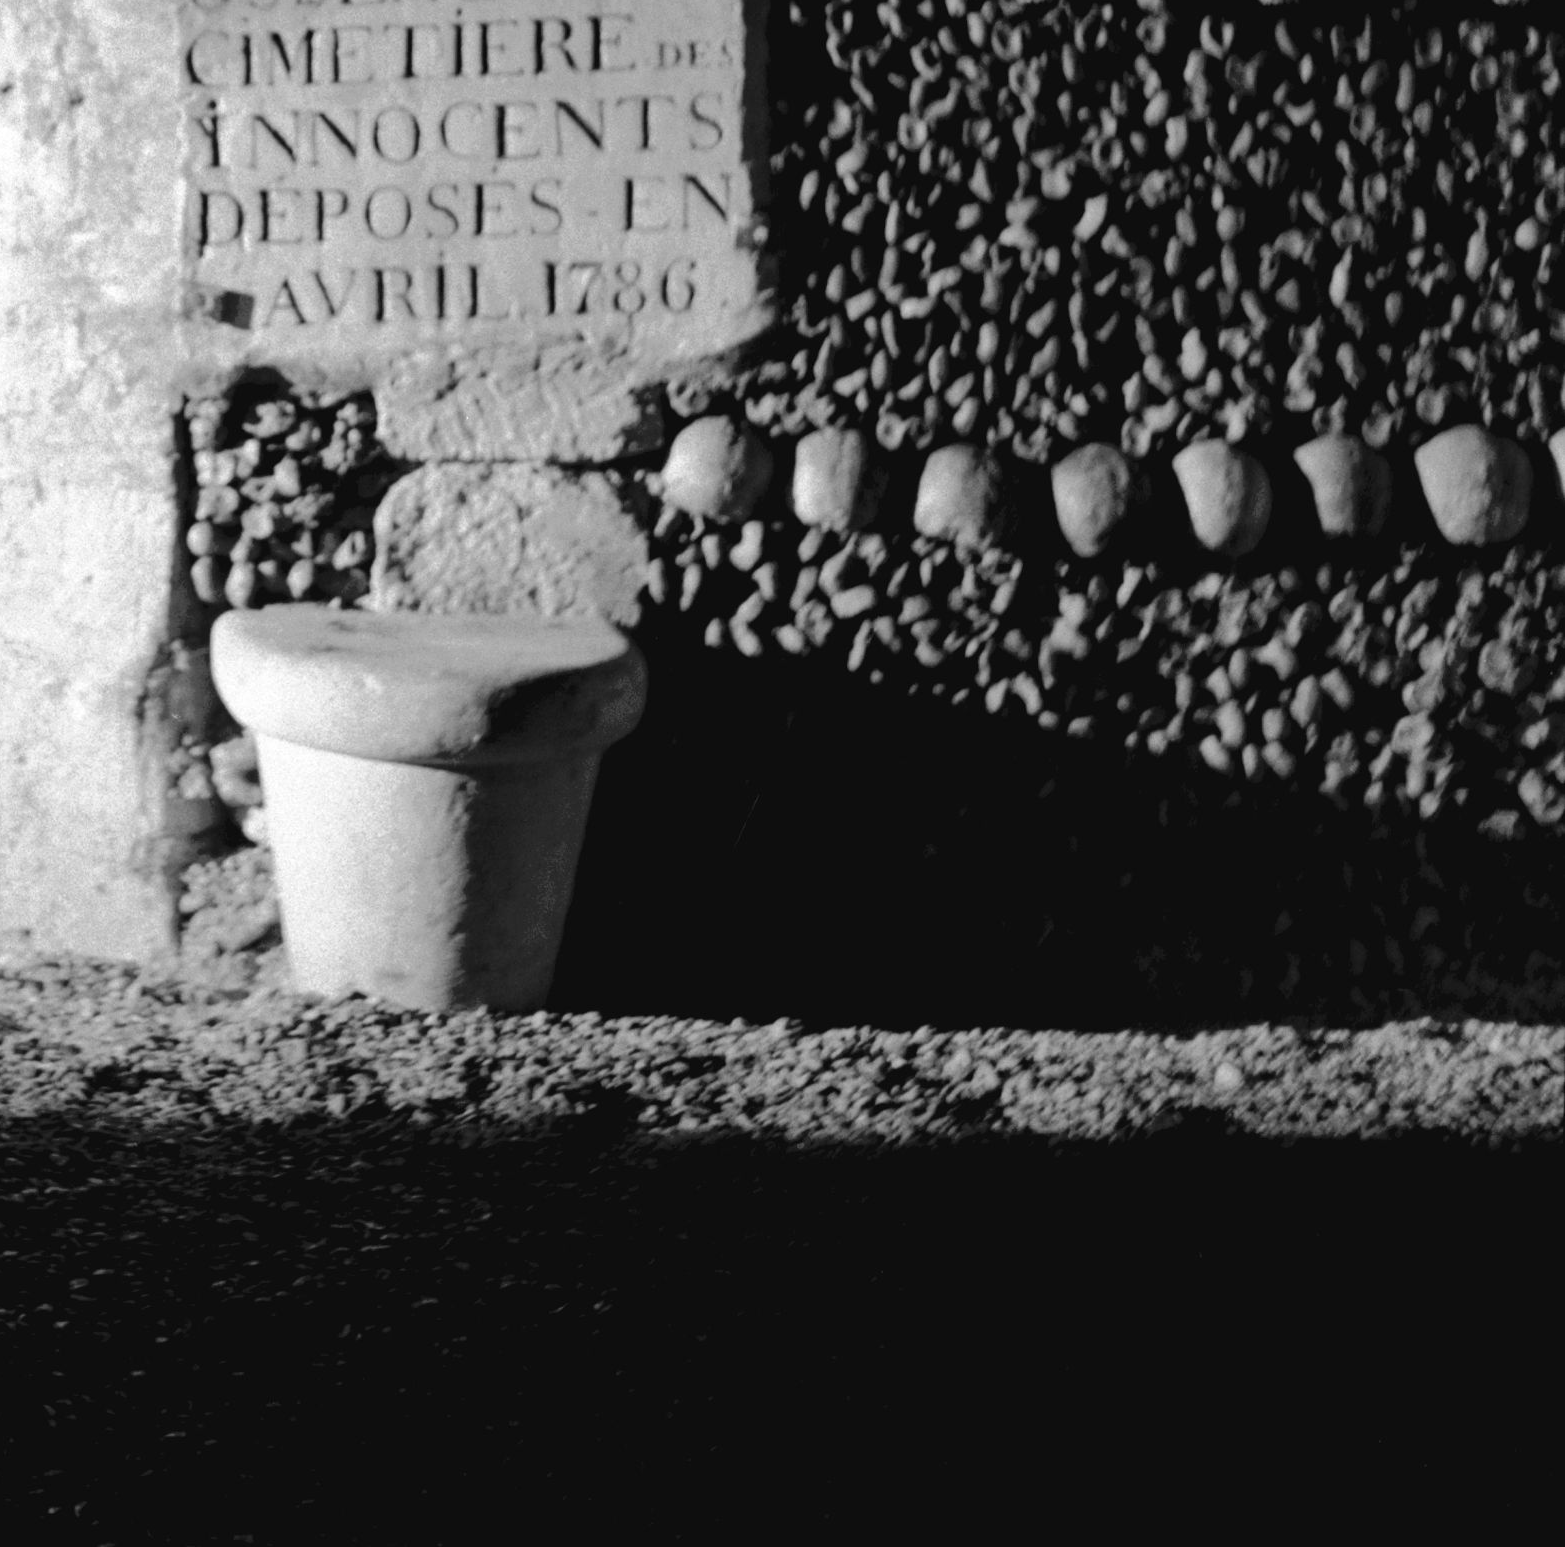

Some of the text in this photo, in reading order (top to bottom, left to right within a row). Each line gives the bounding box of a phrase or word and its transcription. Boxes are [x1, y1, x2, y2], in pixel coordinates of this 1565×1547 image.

[195, 93, 724, 169] INNOCENTS
[623, 172, 732, 232] EN
[264, 259, 698, 326] AVRIL 1786
